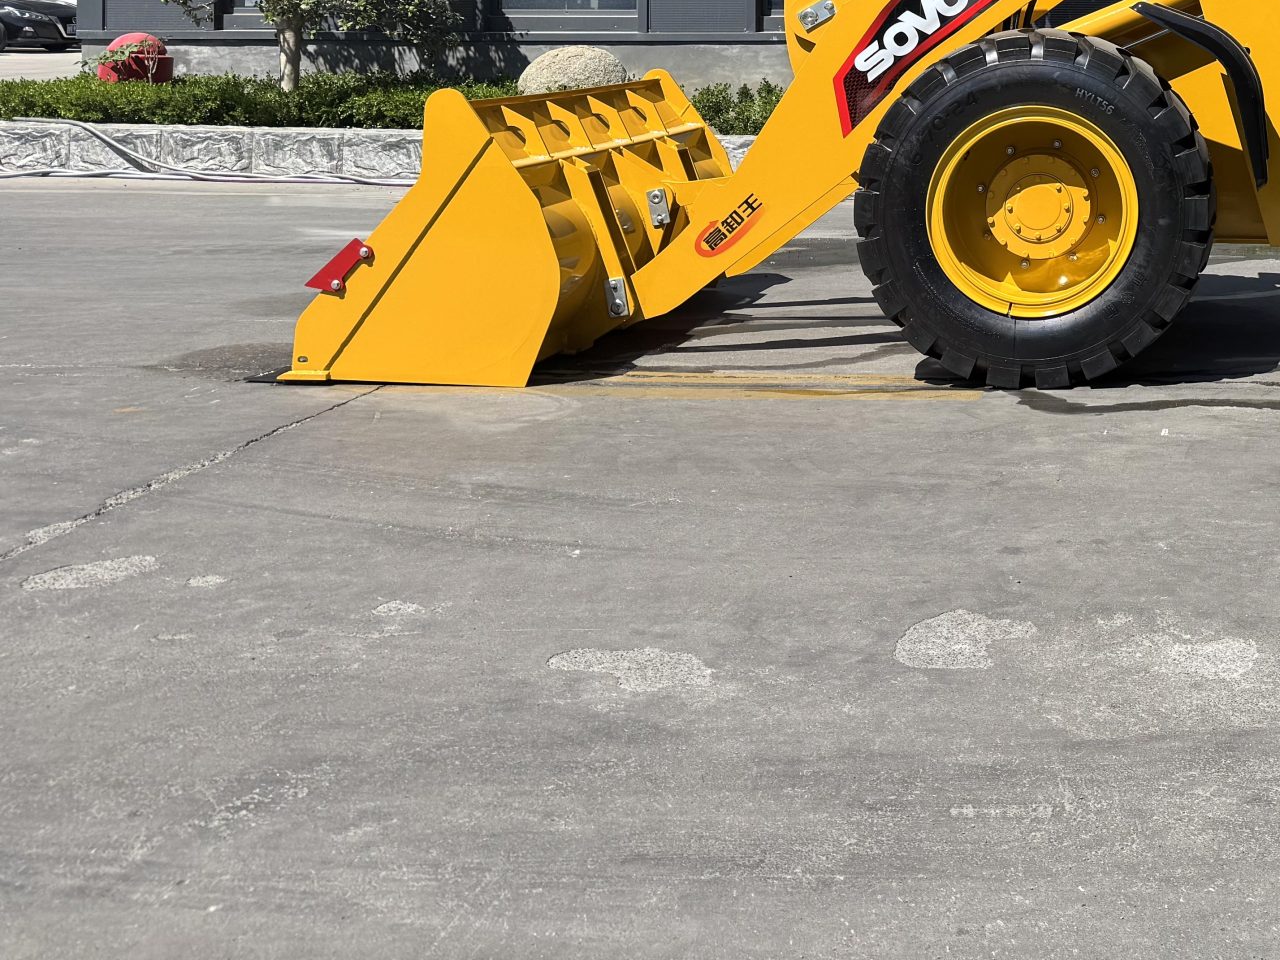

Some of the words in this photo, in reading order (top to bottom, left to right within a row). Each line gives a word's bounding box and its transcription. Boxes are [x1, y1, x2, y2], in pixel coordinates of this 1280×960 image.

[1075, 87, 1115, 115] HYLT56
[703, 192, 763, 251] 高卸王
